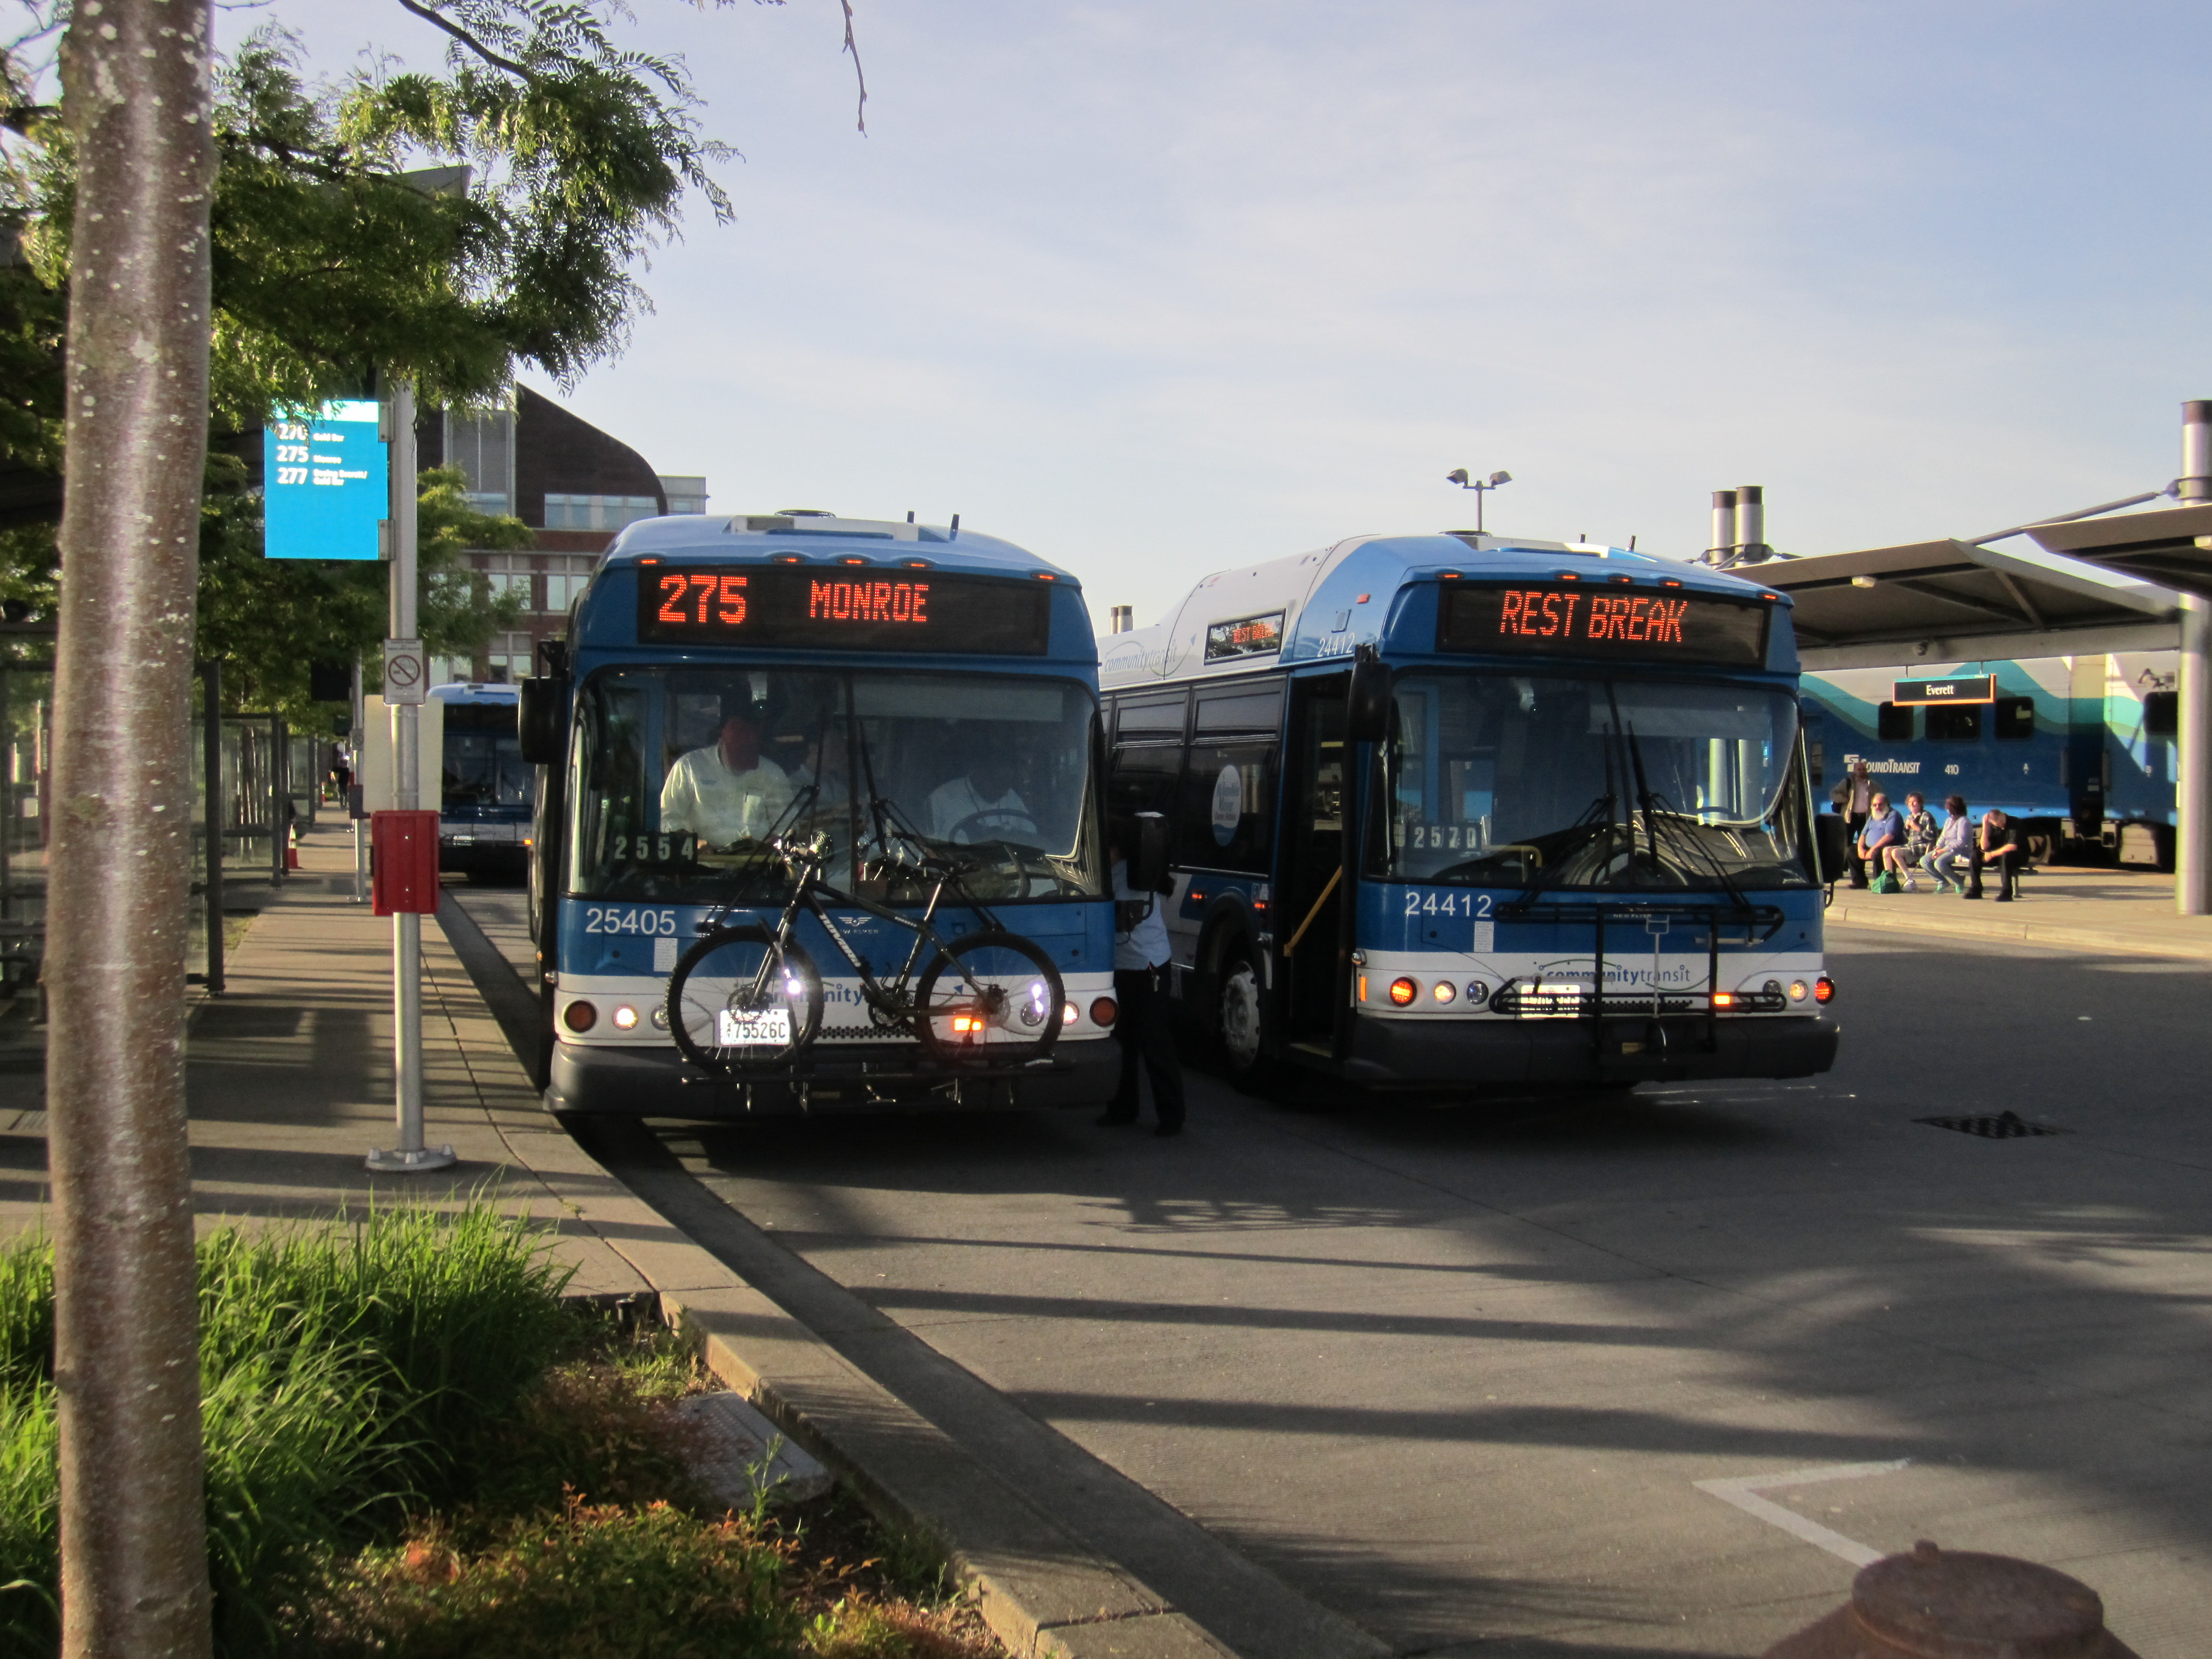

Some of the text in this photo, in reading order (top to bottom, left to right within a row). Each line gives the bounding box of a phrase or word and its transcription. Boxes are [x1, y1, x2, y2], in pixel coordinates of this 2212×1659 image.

[277, 445, 309, 462] 275
[278, 467, 308, 484] 277
[659, 575, 929, 624] 275 MONROE
[1500, 590, 1688, 643] REST BREAK
[1317, 632, 1355, 657] 24412
[1926, 685, 1954, 695] Everett
[1945, 764, 1960, 775] 410
[614, 836, 694, 860] 2554
[1414, 826, 1476, 849] 2570
[1405, 892, 1492, 918] 24412
[585, 908, 676, 935] 25405
[735, 1022, 786, 1039] 75526C
